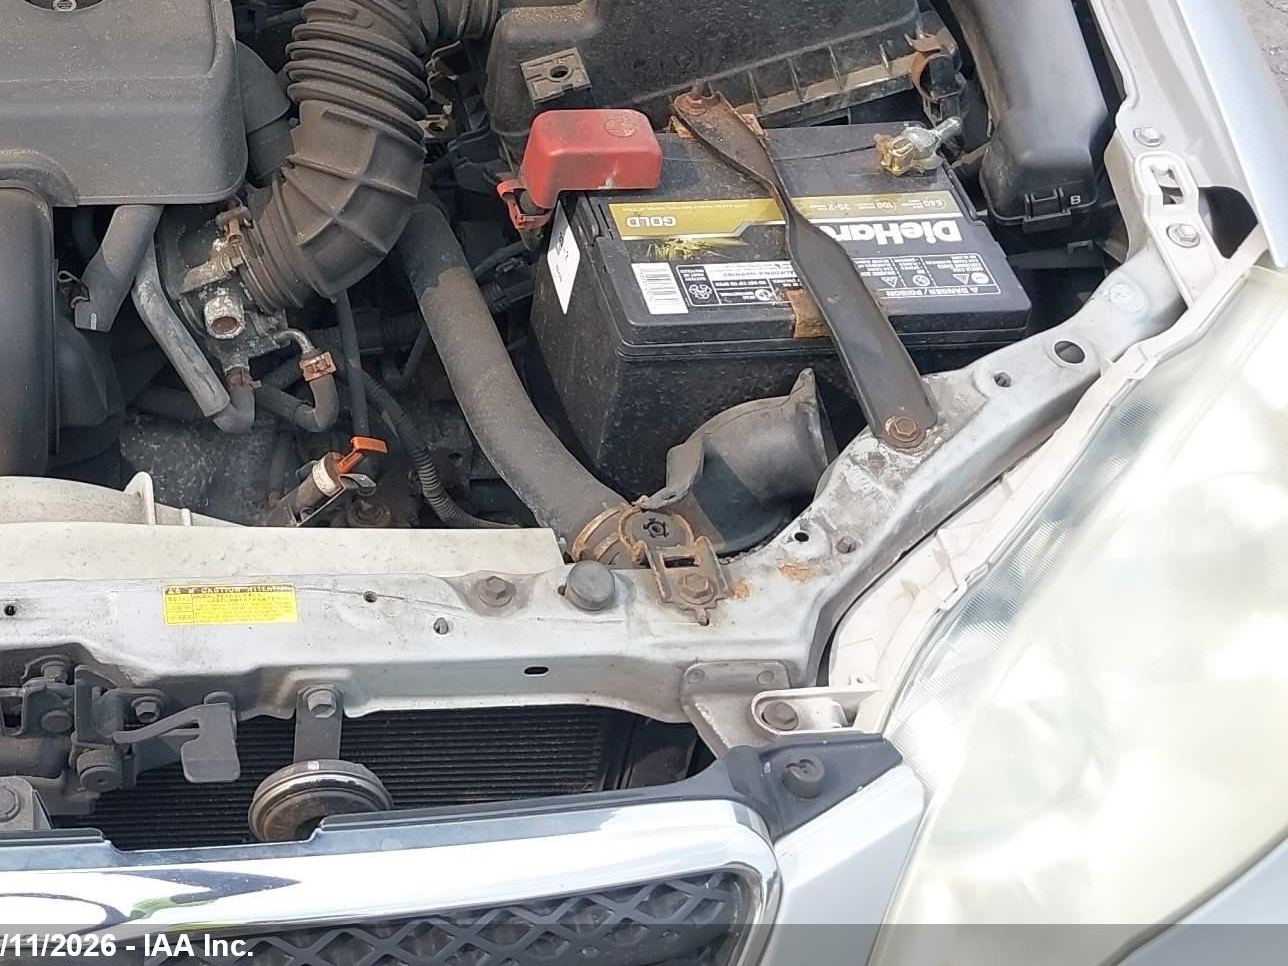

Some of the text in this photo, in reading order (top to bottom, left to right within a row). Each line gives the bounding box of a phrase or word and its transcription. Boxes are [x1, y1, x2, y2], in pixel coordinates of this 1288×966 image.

[1070, 195, 1081, 205] B
[627, 216, 676, 227] GOLD
[886, 289, 922, 297] POISON
[928, 287, 969, 295] DANGER
